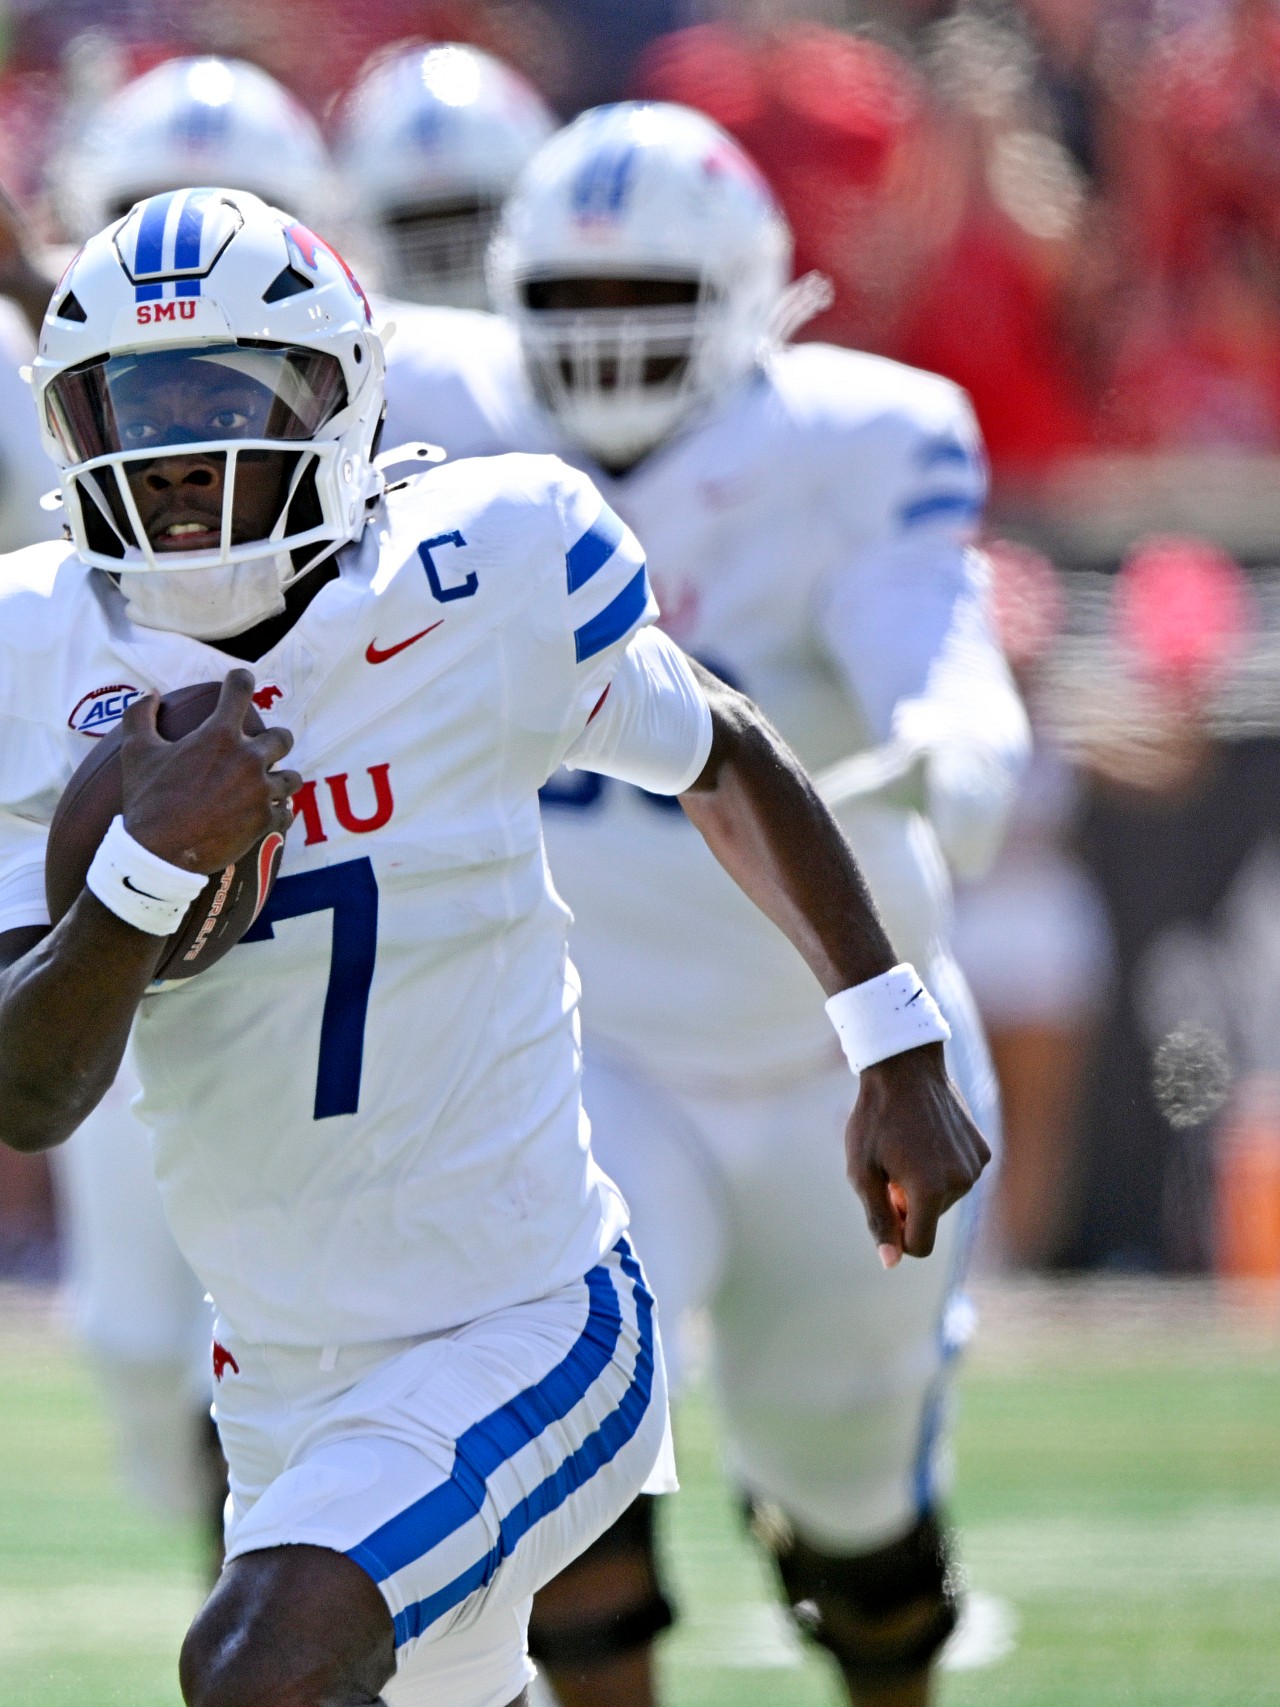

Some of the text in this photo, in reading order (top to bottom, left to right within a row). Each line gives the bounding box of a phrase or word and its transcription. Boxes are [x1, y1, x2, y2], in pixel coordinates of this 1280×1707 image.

[136, 300, 196, 325] SMU
[417, 529, 479, 603] C
[291, 763, 394, 847] MU
[238, 855, 379, 1120] 7
